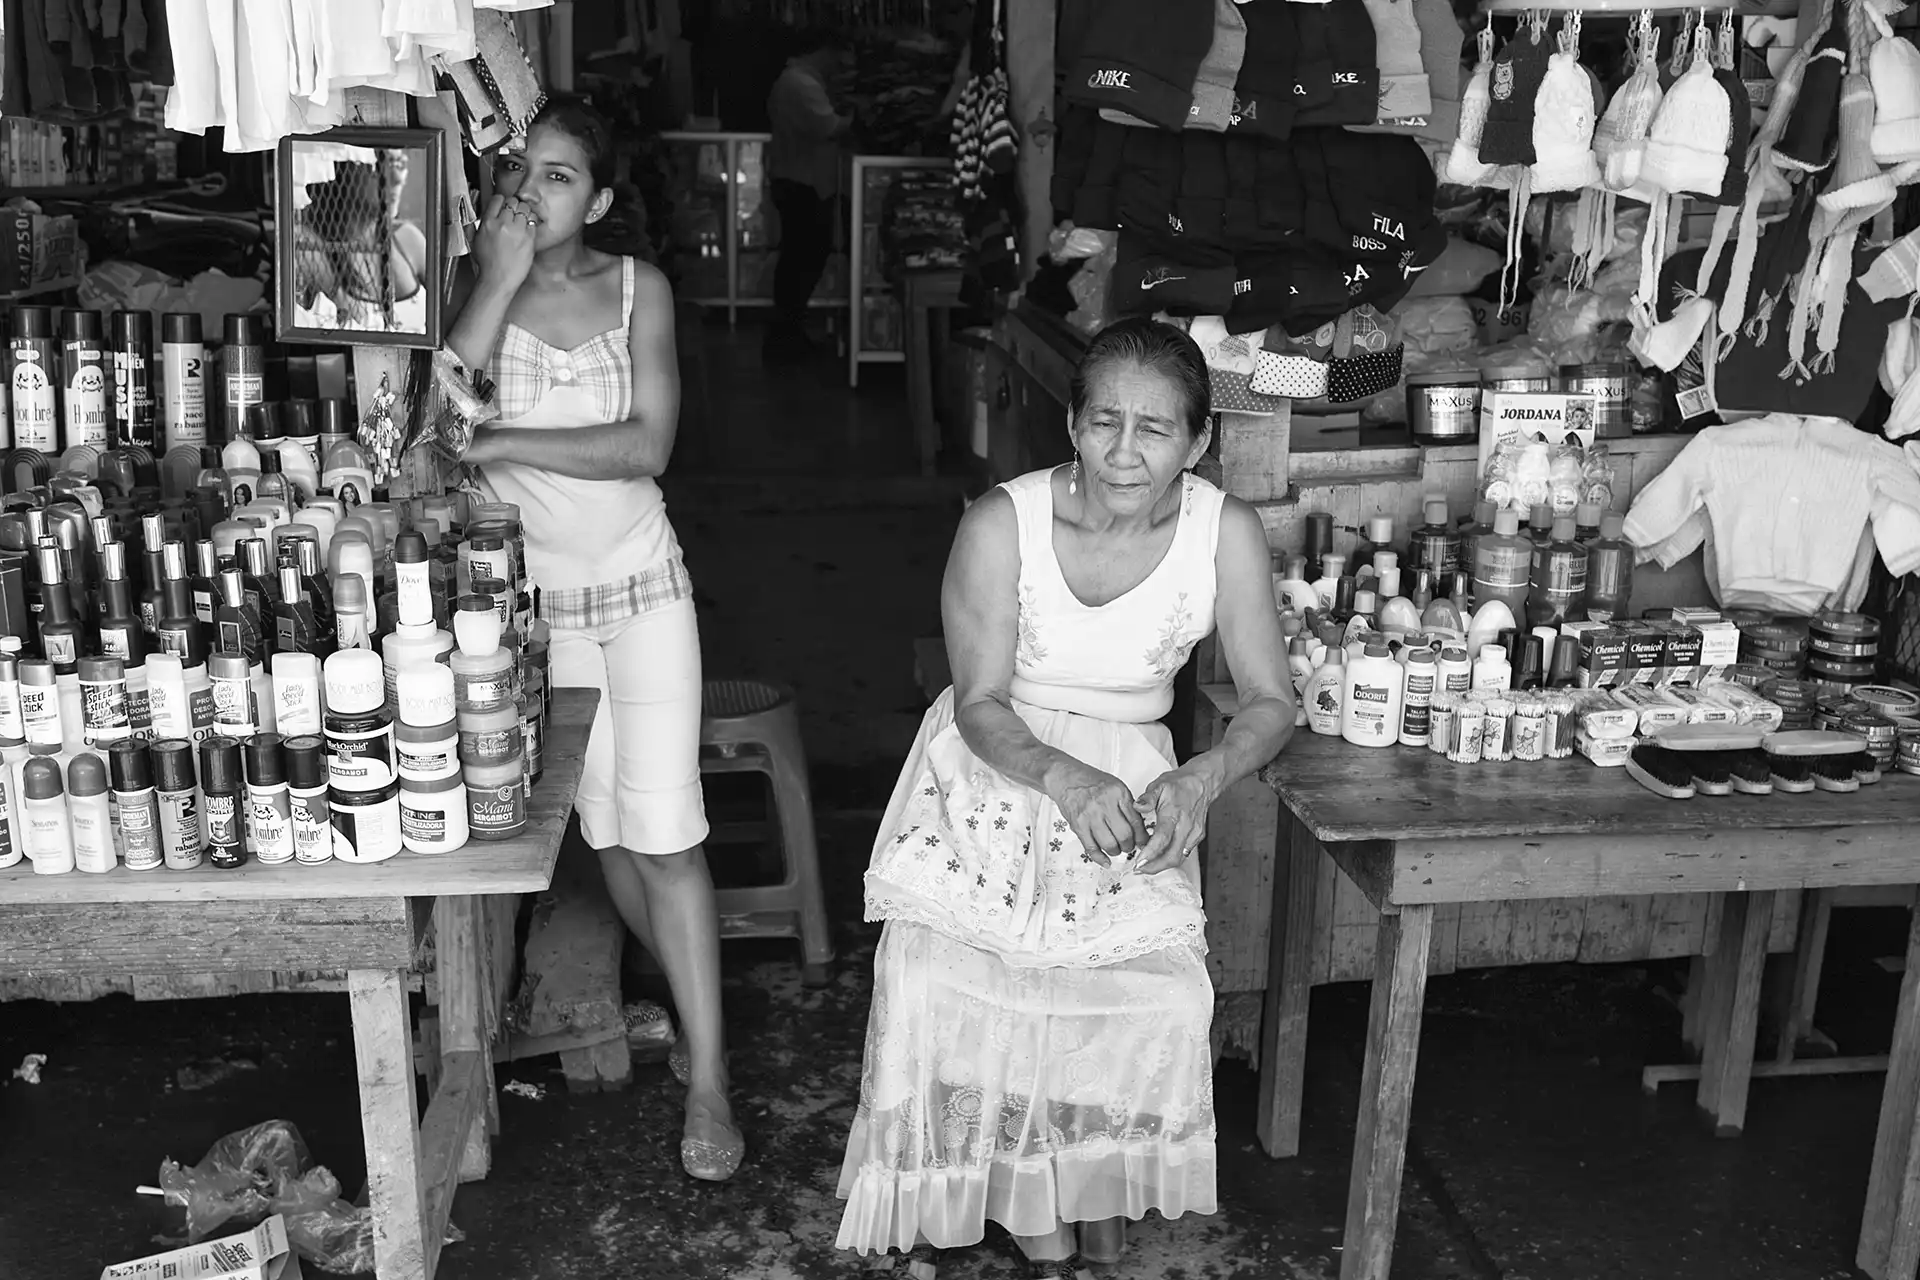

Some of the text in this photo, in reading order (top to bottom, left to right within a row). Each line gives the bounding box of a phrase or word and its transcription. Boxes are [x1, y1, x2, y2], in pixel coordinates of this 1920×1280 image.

[1097, 69, 1131, 88] NIKE
[1331, 72, 1359, 84] IKE
[1372, 212, 1405, 241] FILA
[1352, 234, 1387, 251] BOSS
[1429, 397, 1473, 408] MAXUS
[1500, 408, 1562, 420] JORDANA
[1595, 642, 1627, 655] Chemicol
[1630, 640, 1664, 653] Chemicol
[1668, 639, 1701, 651] Chemicol
[23, 691, 44, 704] PEED
[1355, 689, 1387, 701] ODORIT
[402, 805, 436, 820] UTRINE
[473, 811, 514, 822] BERGAMOT
[256, 822, 281, 841] ombre
[296, 825, 320, 842] ombre
